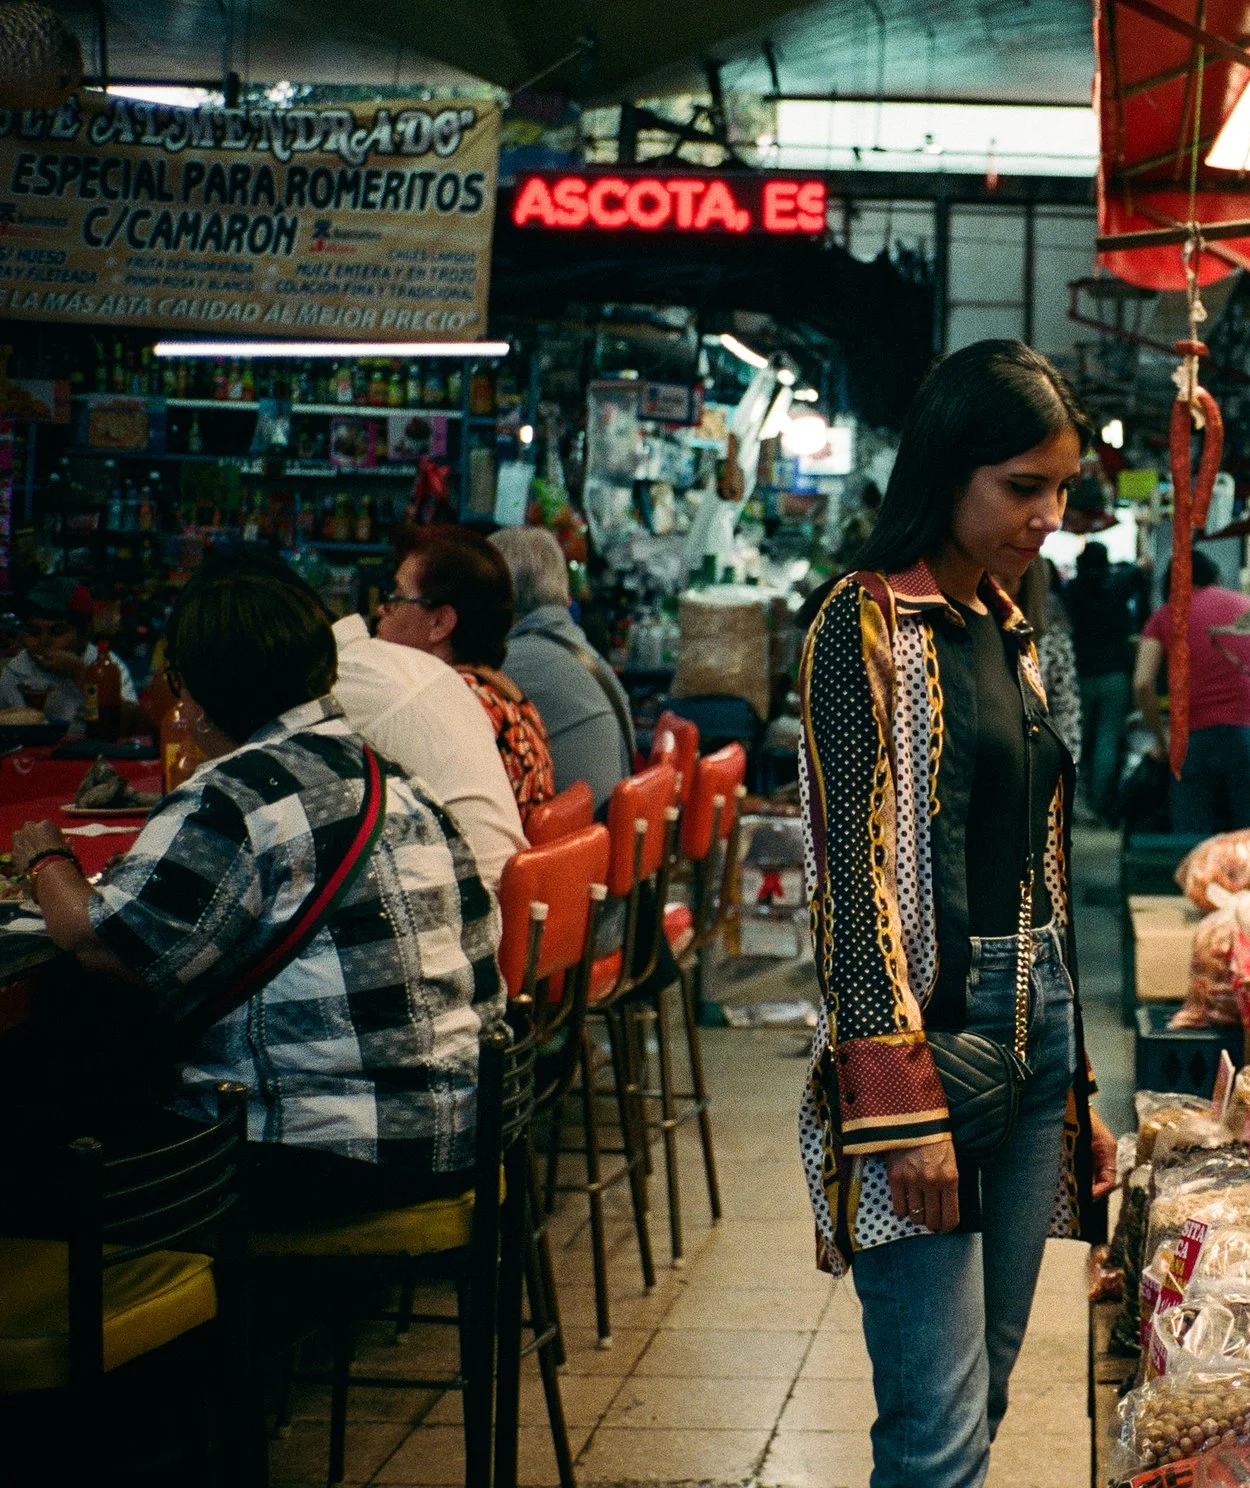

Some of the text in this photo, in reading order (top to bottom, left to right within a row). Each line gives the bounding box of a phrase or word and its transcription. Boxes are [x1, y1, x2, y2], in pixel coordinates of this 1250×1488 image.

[12, 153, 484, 213] ESPECIAL PARA ROMERITOS
[514, 177, 749, 232] ASCOTA,
[18, 249, 66, 265] HUESO
[10, 290, 39, 308] LA
[99, 294, 152, 317] ALTA
[157, 298, 261, 322] CALIDAD
[263, 301, 295, 325] AL
[296, 304, 377, 329] MEJOR
